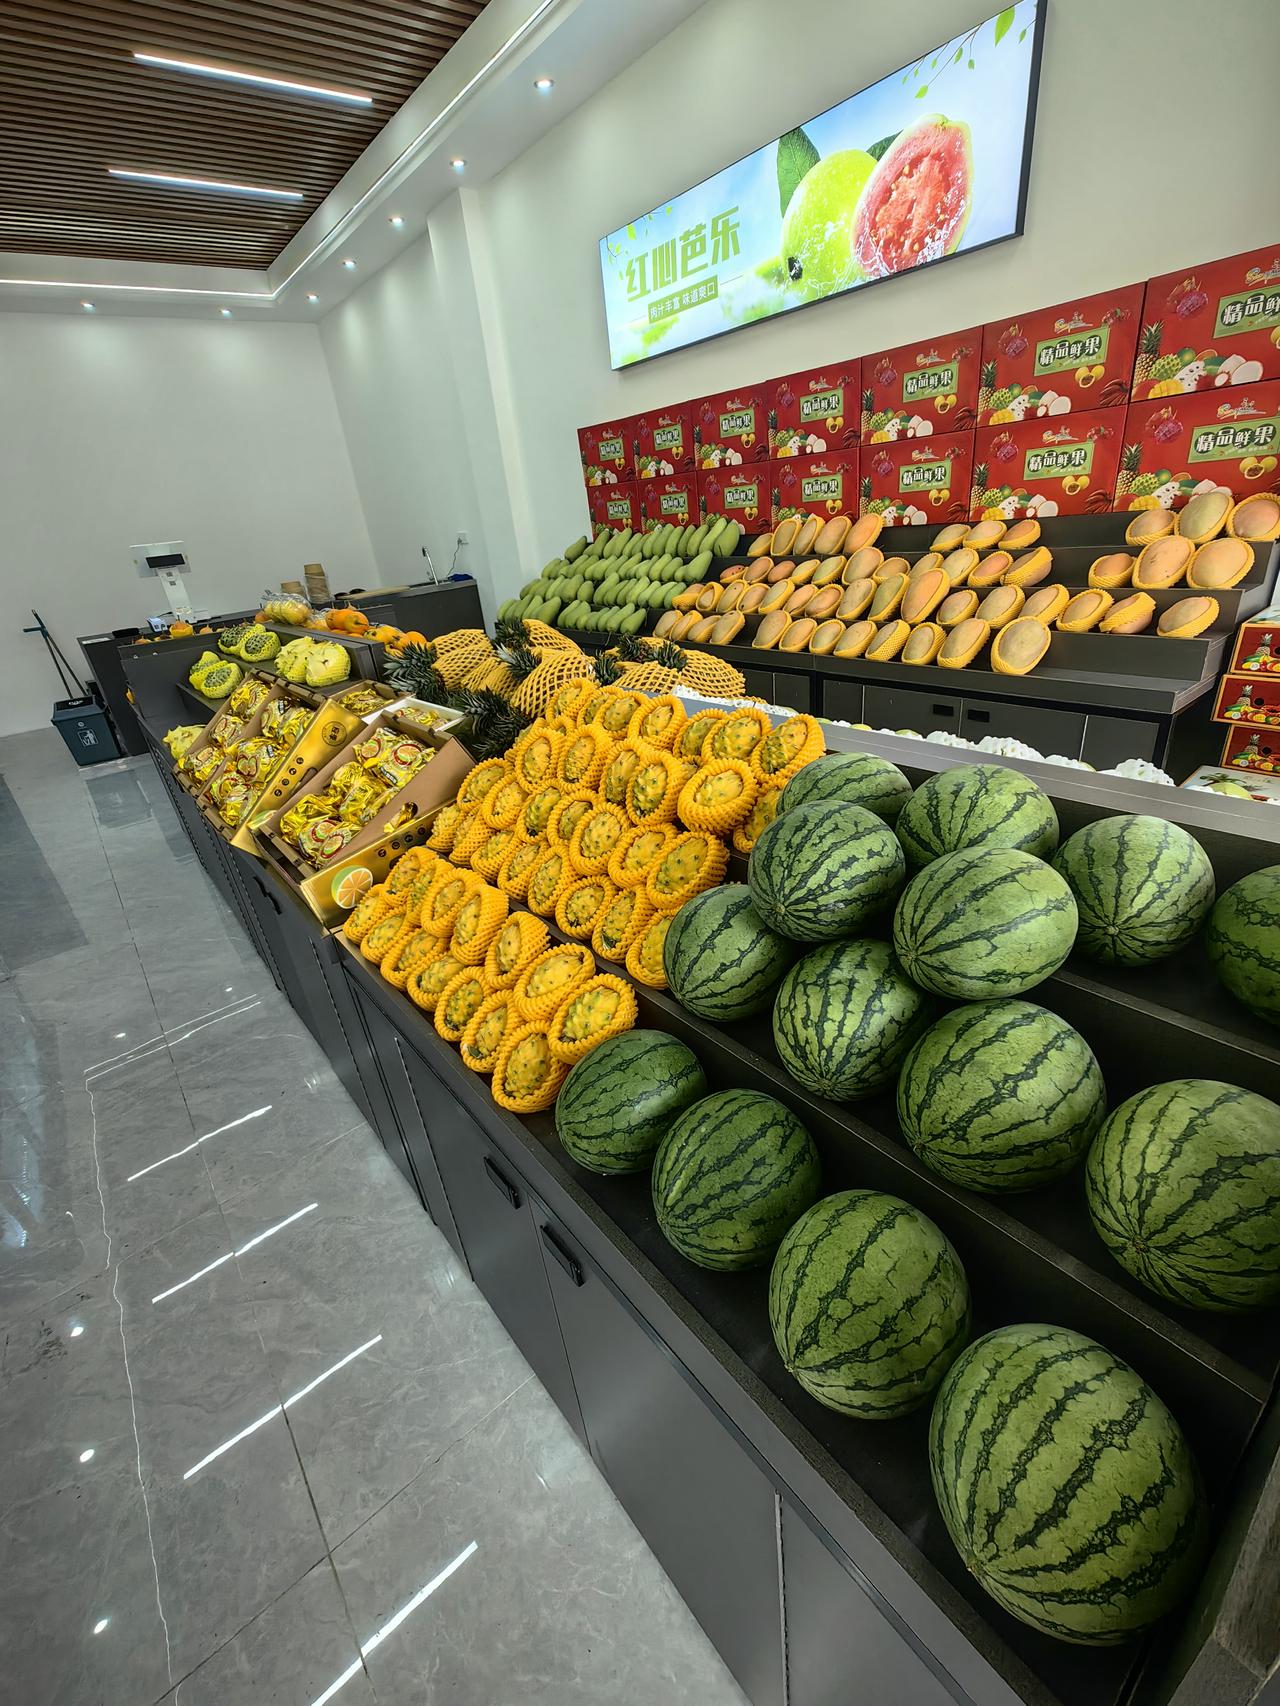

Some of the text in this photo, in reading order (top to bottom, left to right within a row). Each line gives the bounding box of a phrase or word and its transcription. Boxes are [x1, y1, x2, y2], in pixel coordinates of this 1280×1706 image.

[626, 205, 740, 302] 红心芭乐
[1040, 337, 1100, 365] 精品鲜果
[906, 371, 952, 393] 精品鲜果
[803, 396, 838, 415] 精品鲜果
[1196, 425, 1274, 452] 精品鲜果
[1029, 450, 1085, 471] 精品鲜果
[902, 466, 946, 485] 精品鲜果
[804, 479, 838, 496] 精品鲜果
